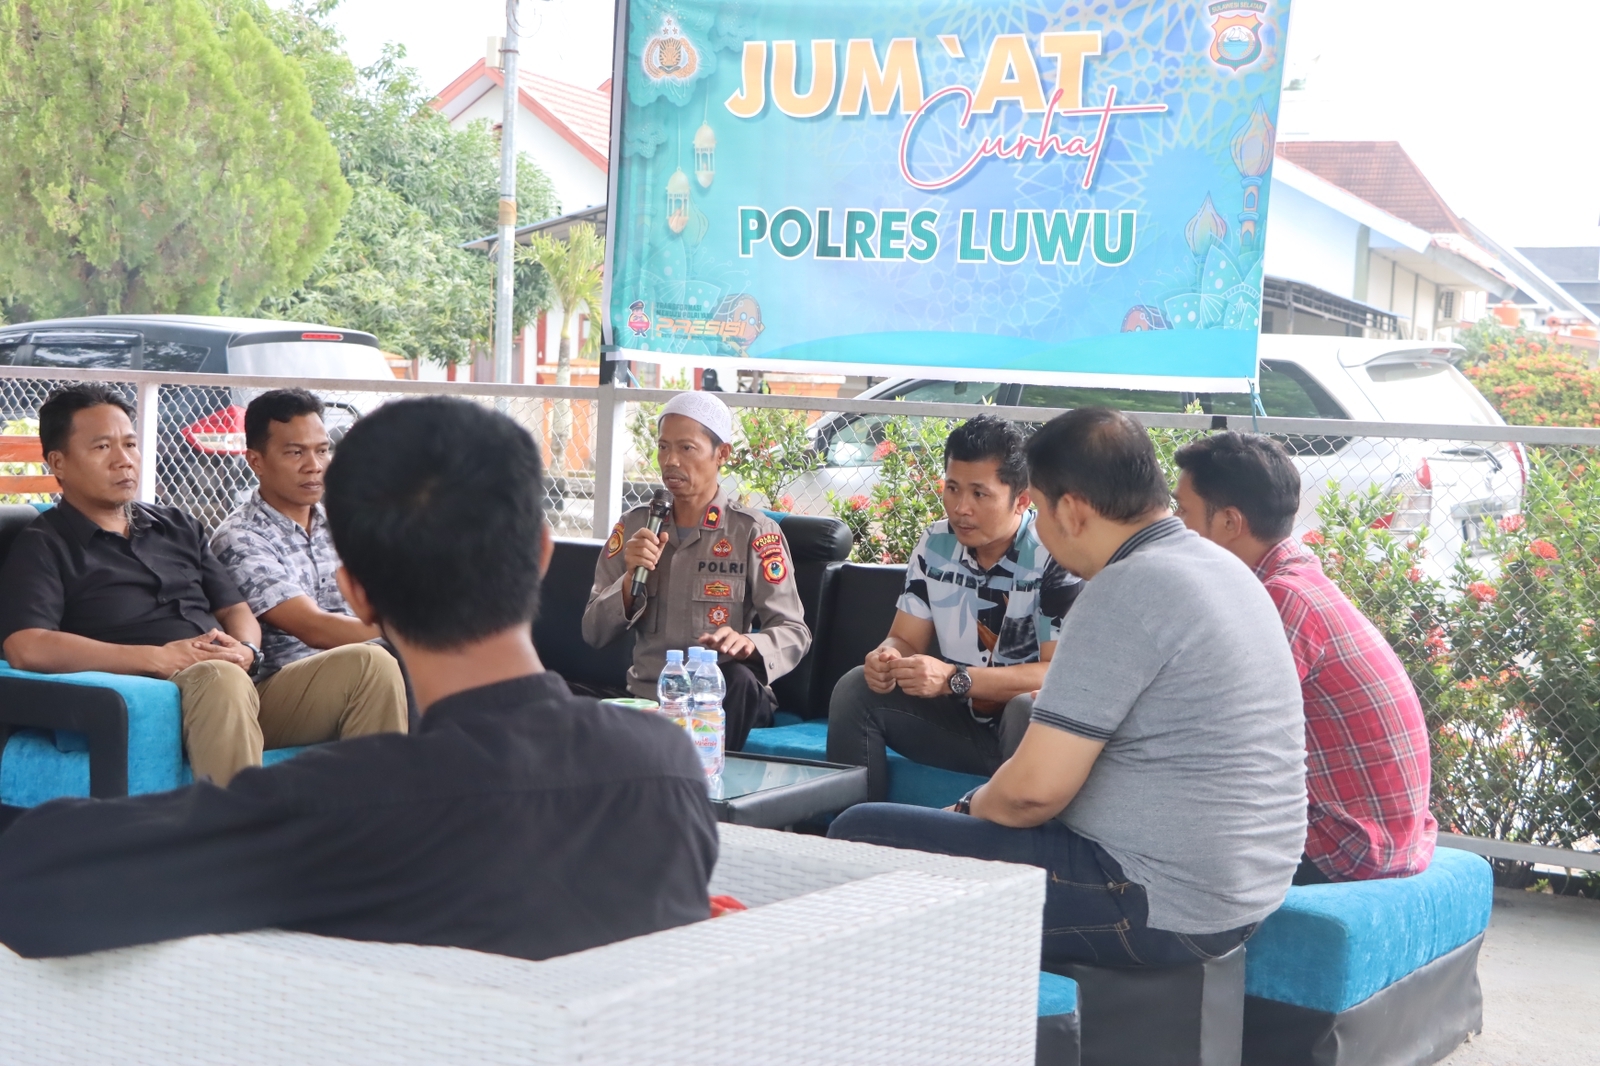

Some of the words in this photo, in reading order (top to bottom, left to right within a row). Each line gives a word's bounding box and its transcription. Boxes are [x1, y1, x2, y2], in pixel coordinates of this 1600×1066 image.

[899, 84, 1168, 190] Curhat
[737, 205, 941, 264] POLRES
[957, 208, 1138, 267] LUWU
[656, 302, 702, 311] TRANSFORMASI
[682, 311, 700, 319] POLRI
[656, 317, 747, 338] PRESISI
[698, 561, 744, 574] POLRI
